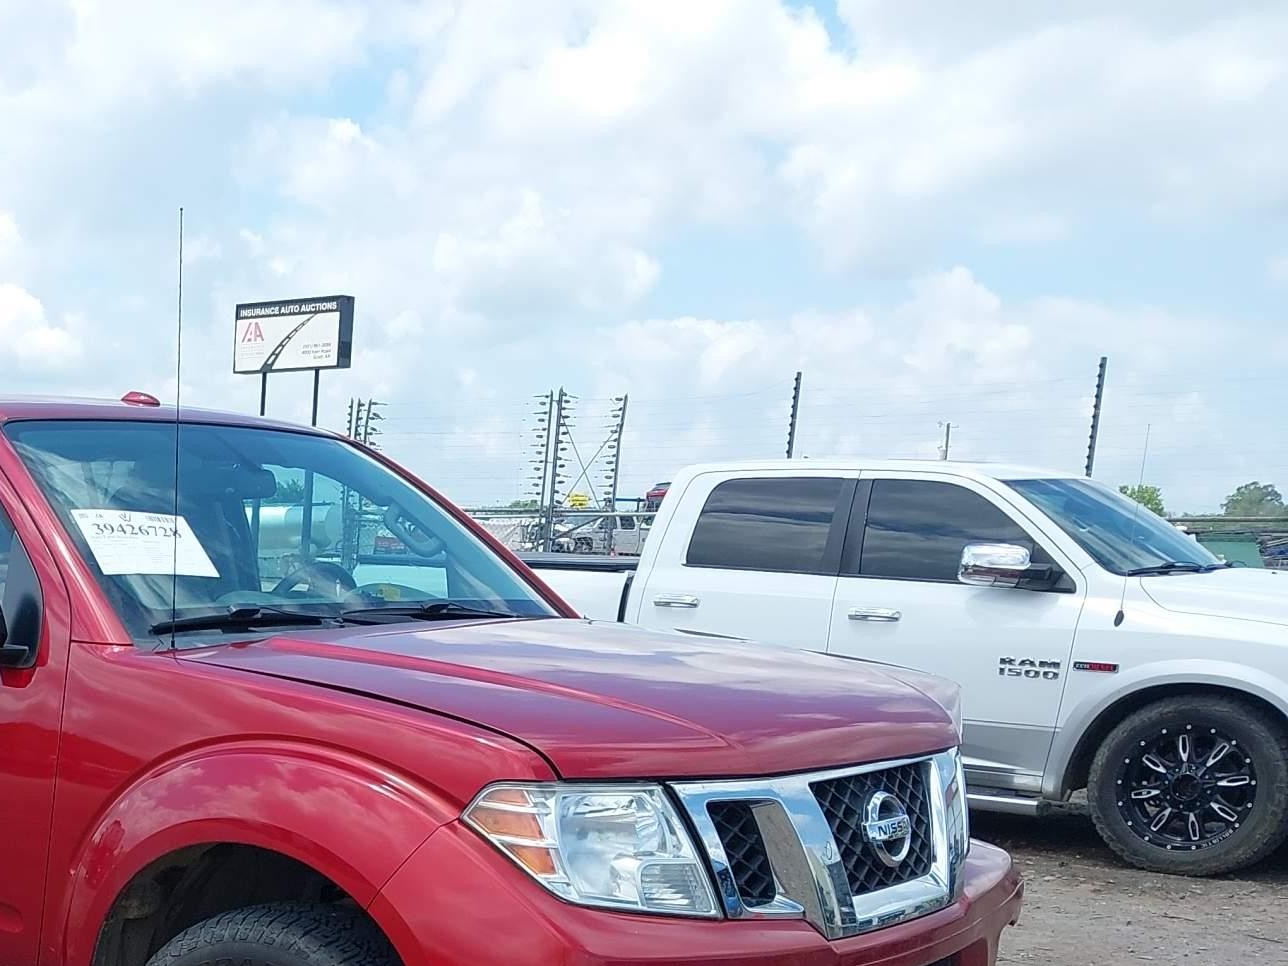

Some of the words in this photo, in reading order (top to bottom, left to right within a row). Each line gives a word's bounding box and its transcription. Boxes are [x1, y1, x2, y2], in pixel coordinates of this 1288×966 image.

[240, 306, 280, 317] INSURANCE
[280, 304, 300, 314] AUTO
[300, 301, 337, 312] AUCTIONS
[92, 522, 182, 539] 39426728
[999, 657, 1061, 669] RAM
[998, 667, 1060, 680] 1500
